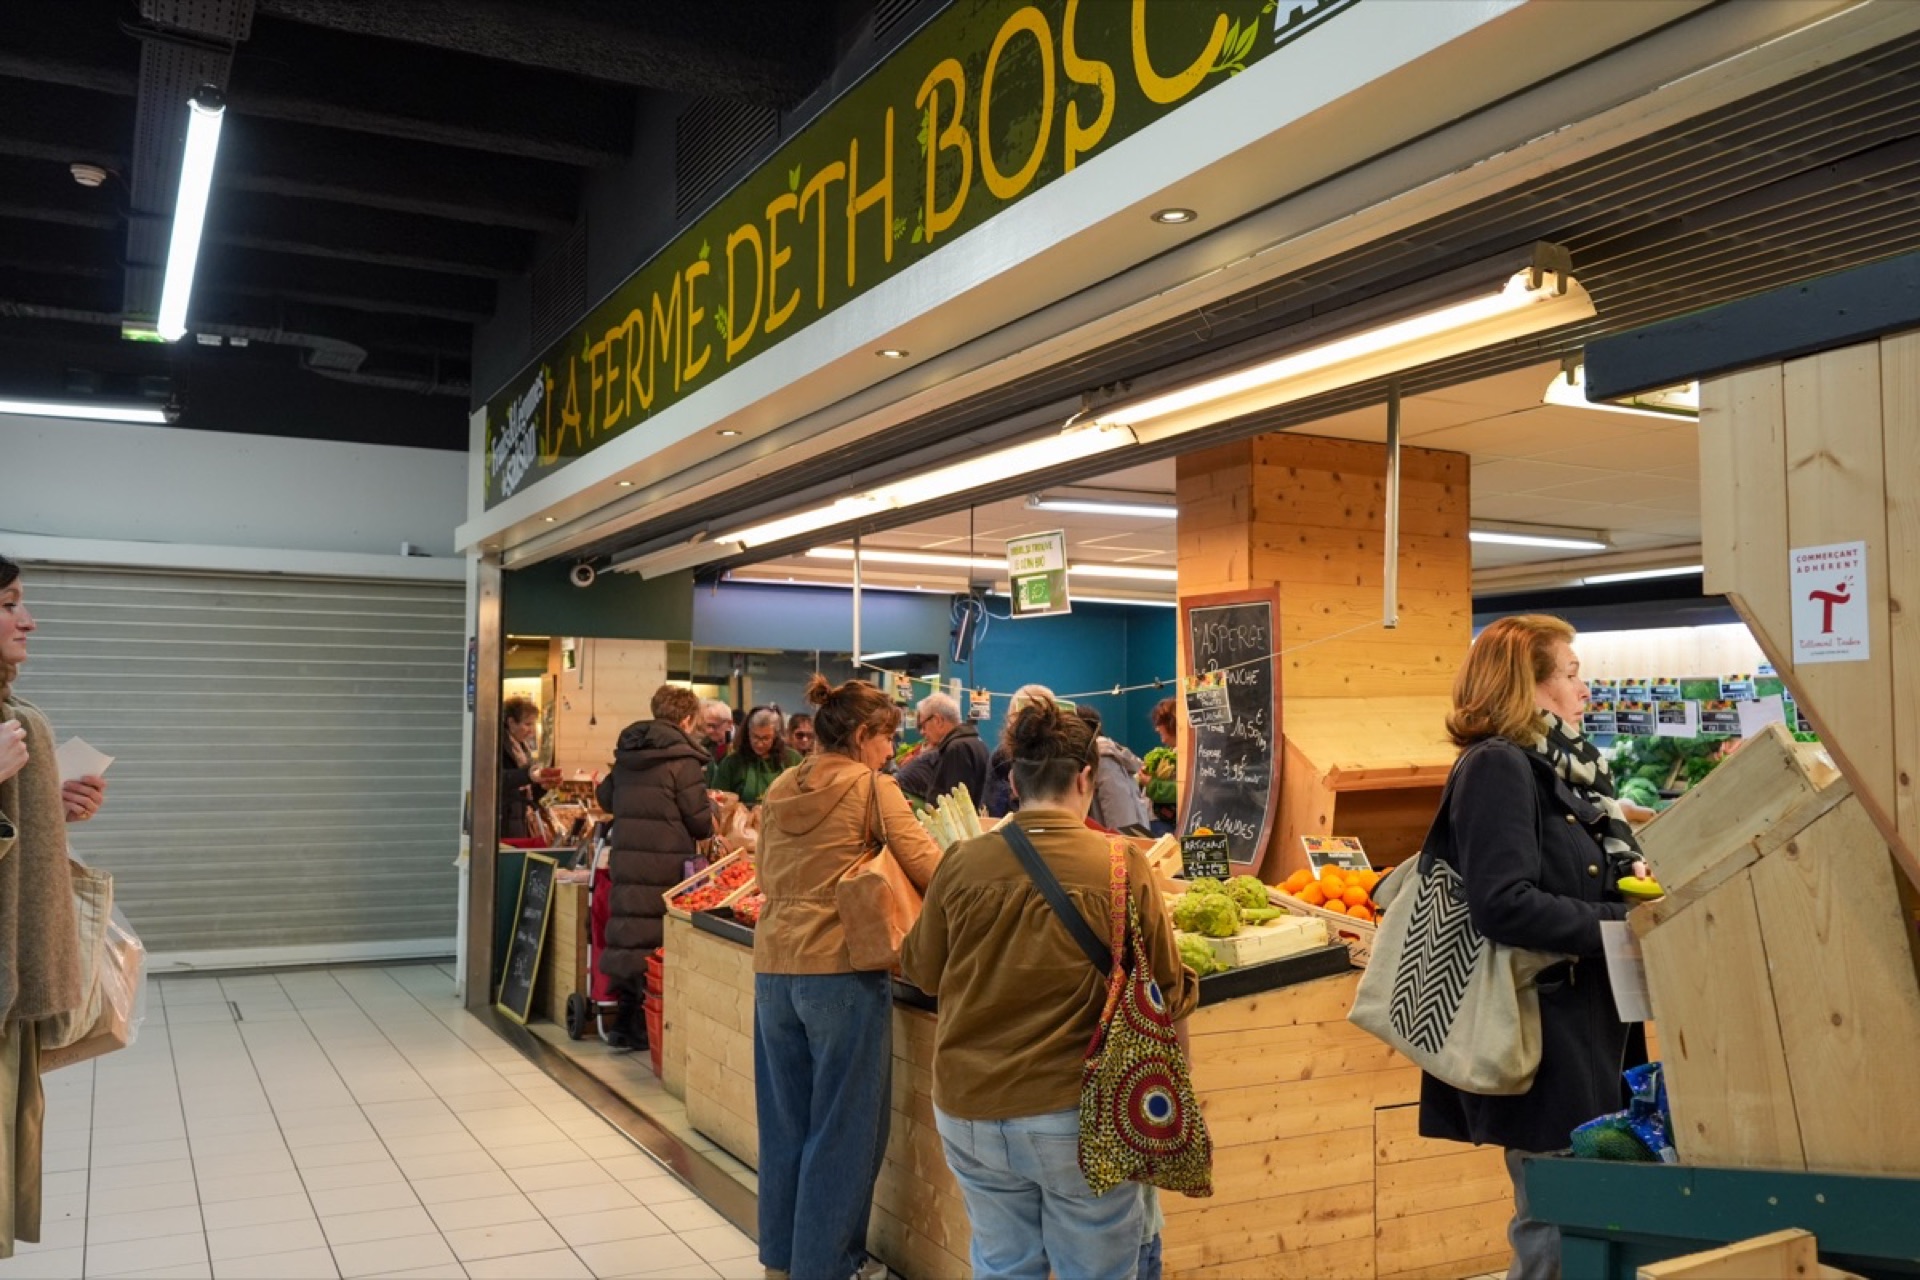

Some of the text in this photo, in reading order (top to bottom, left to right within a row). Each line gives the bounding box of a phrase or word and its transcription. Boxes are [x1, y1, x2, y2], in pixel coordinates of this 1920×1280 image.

[546, 356, 582, 466] LA
[588, 260, 712, 439] FERME
[727, 106, 894, 363] DETH
[1200, 622, 1265, 655] ASPERGE
